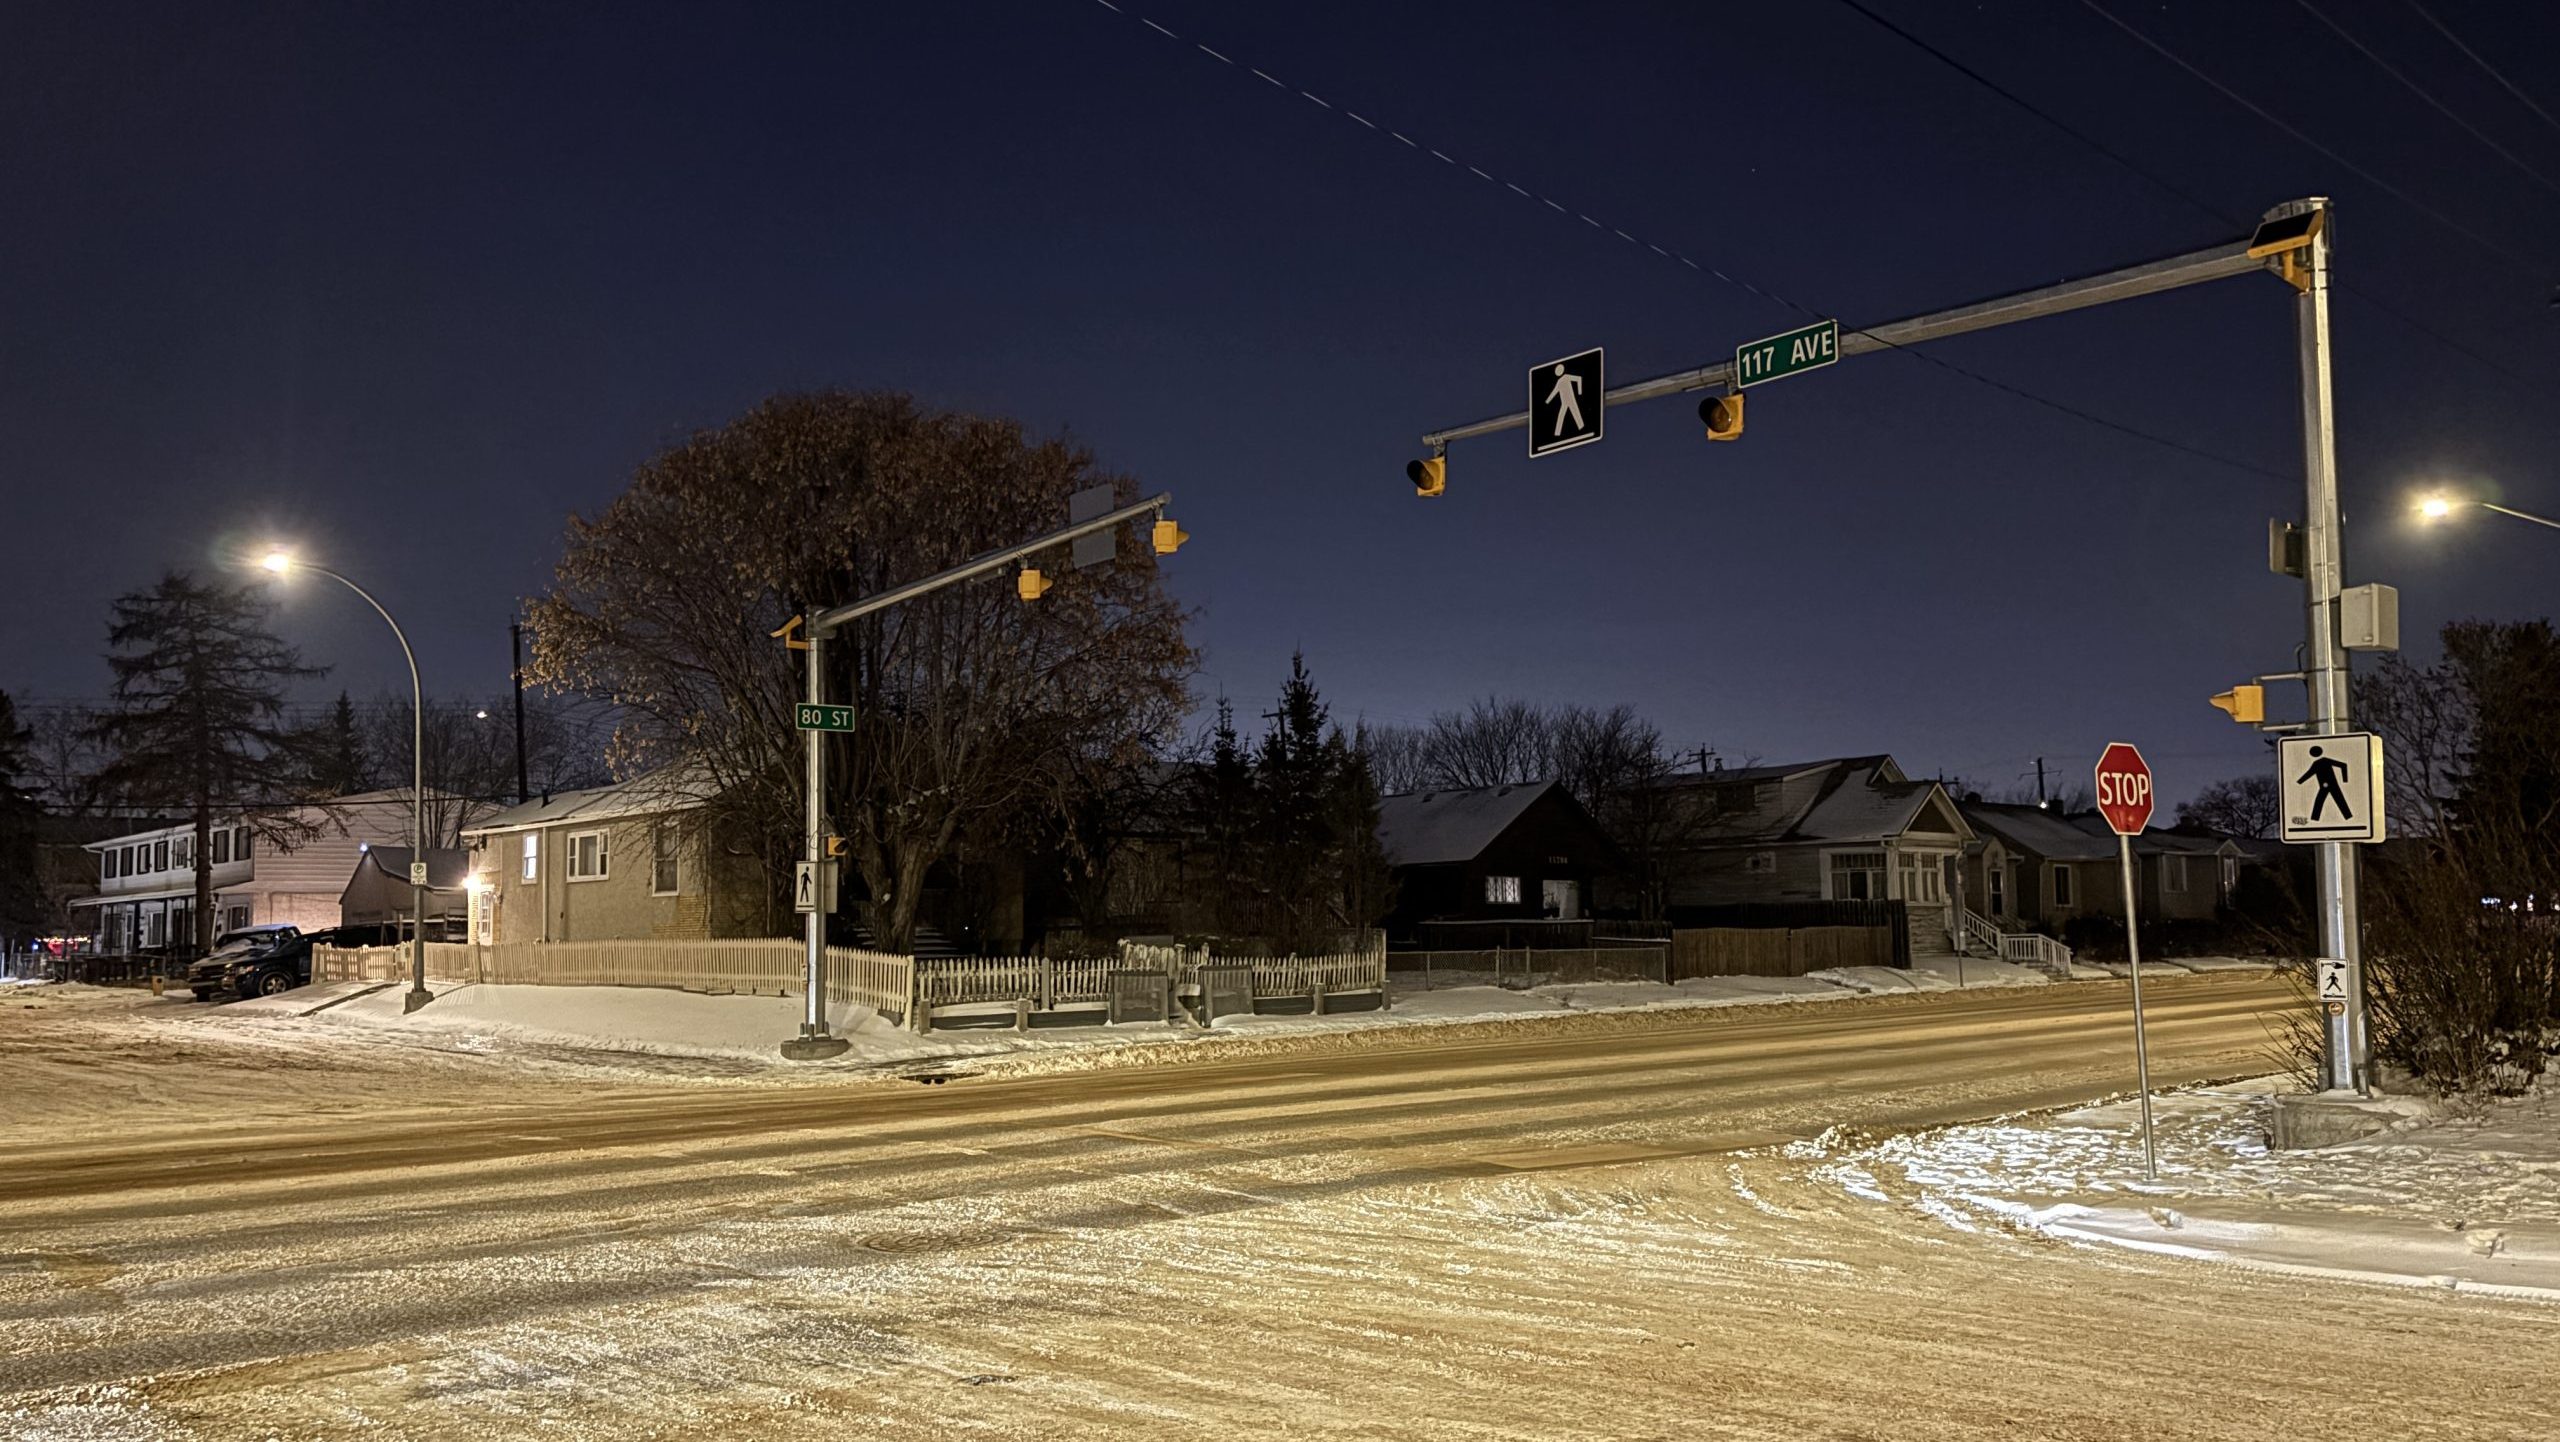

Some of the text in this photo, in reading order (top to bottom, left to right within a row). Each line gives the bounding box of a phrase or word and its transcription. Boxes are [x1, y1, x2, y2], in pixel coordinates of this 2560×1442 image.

[1742, 330, 1833, 377] 117 AVE
[801, 708, 849, 726] 80 ST
[2100, 771, 2149, 806] STOP
